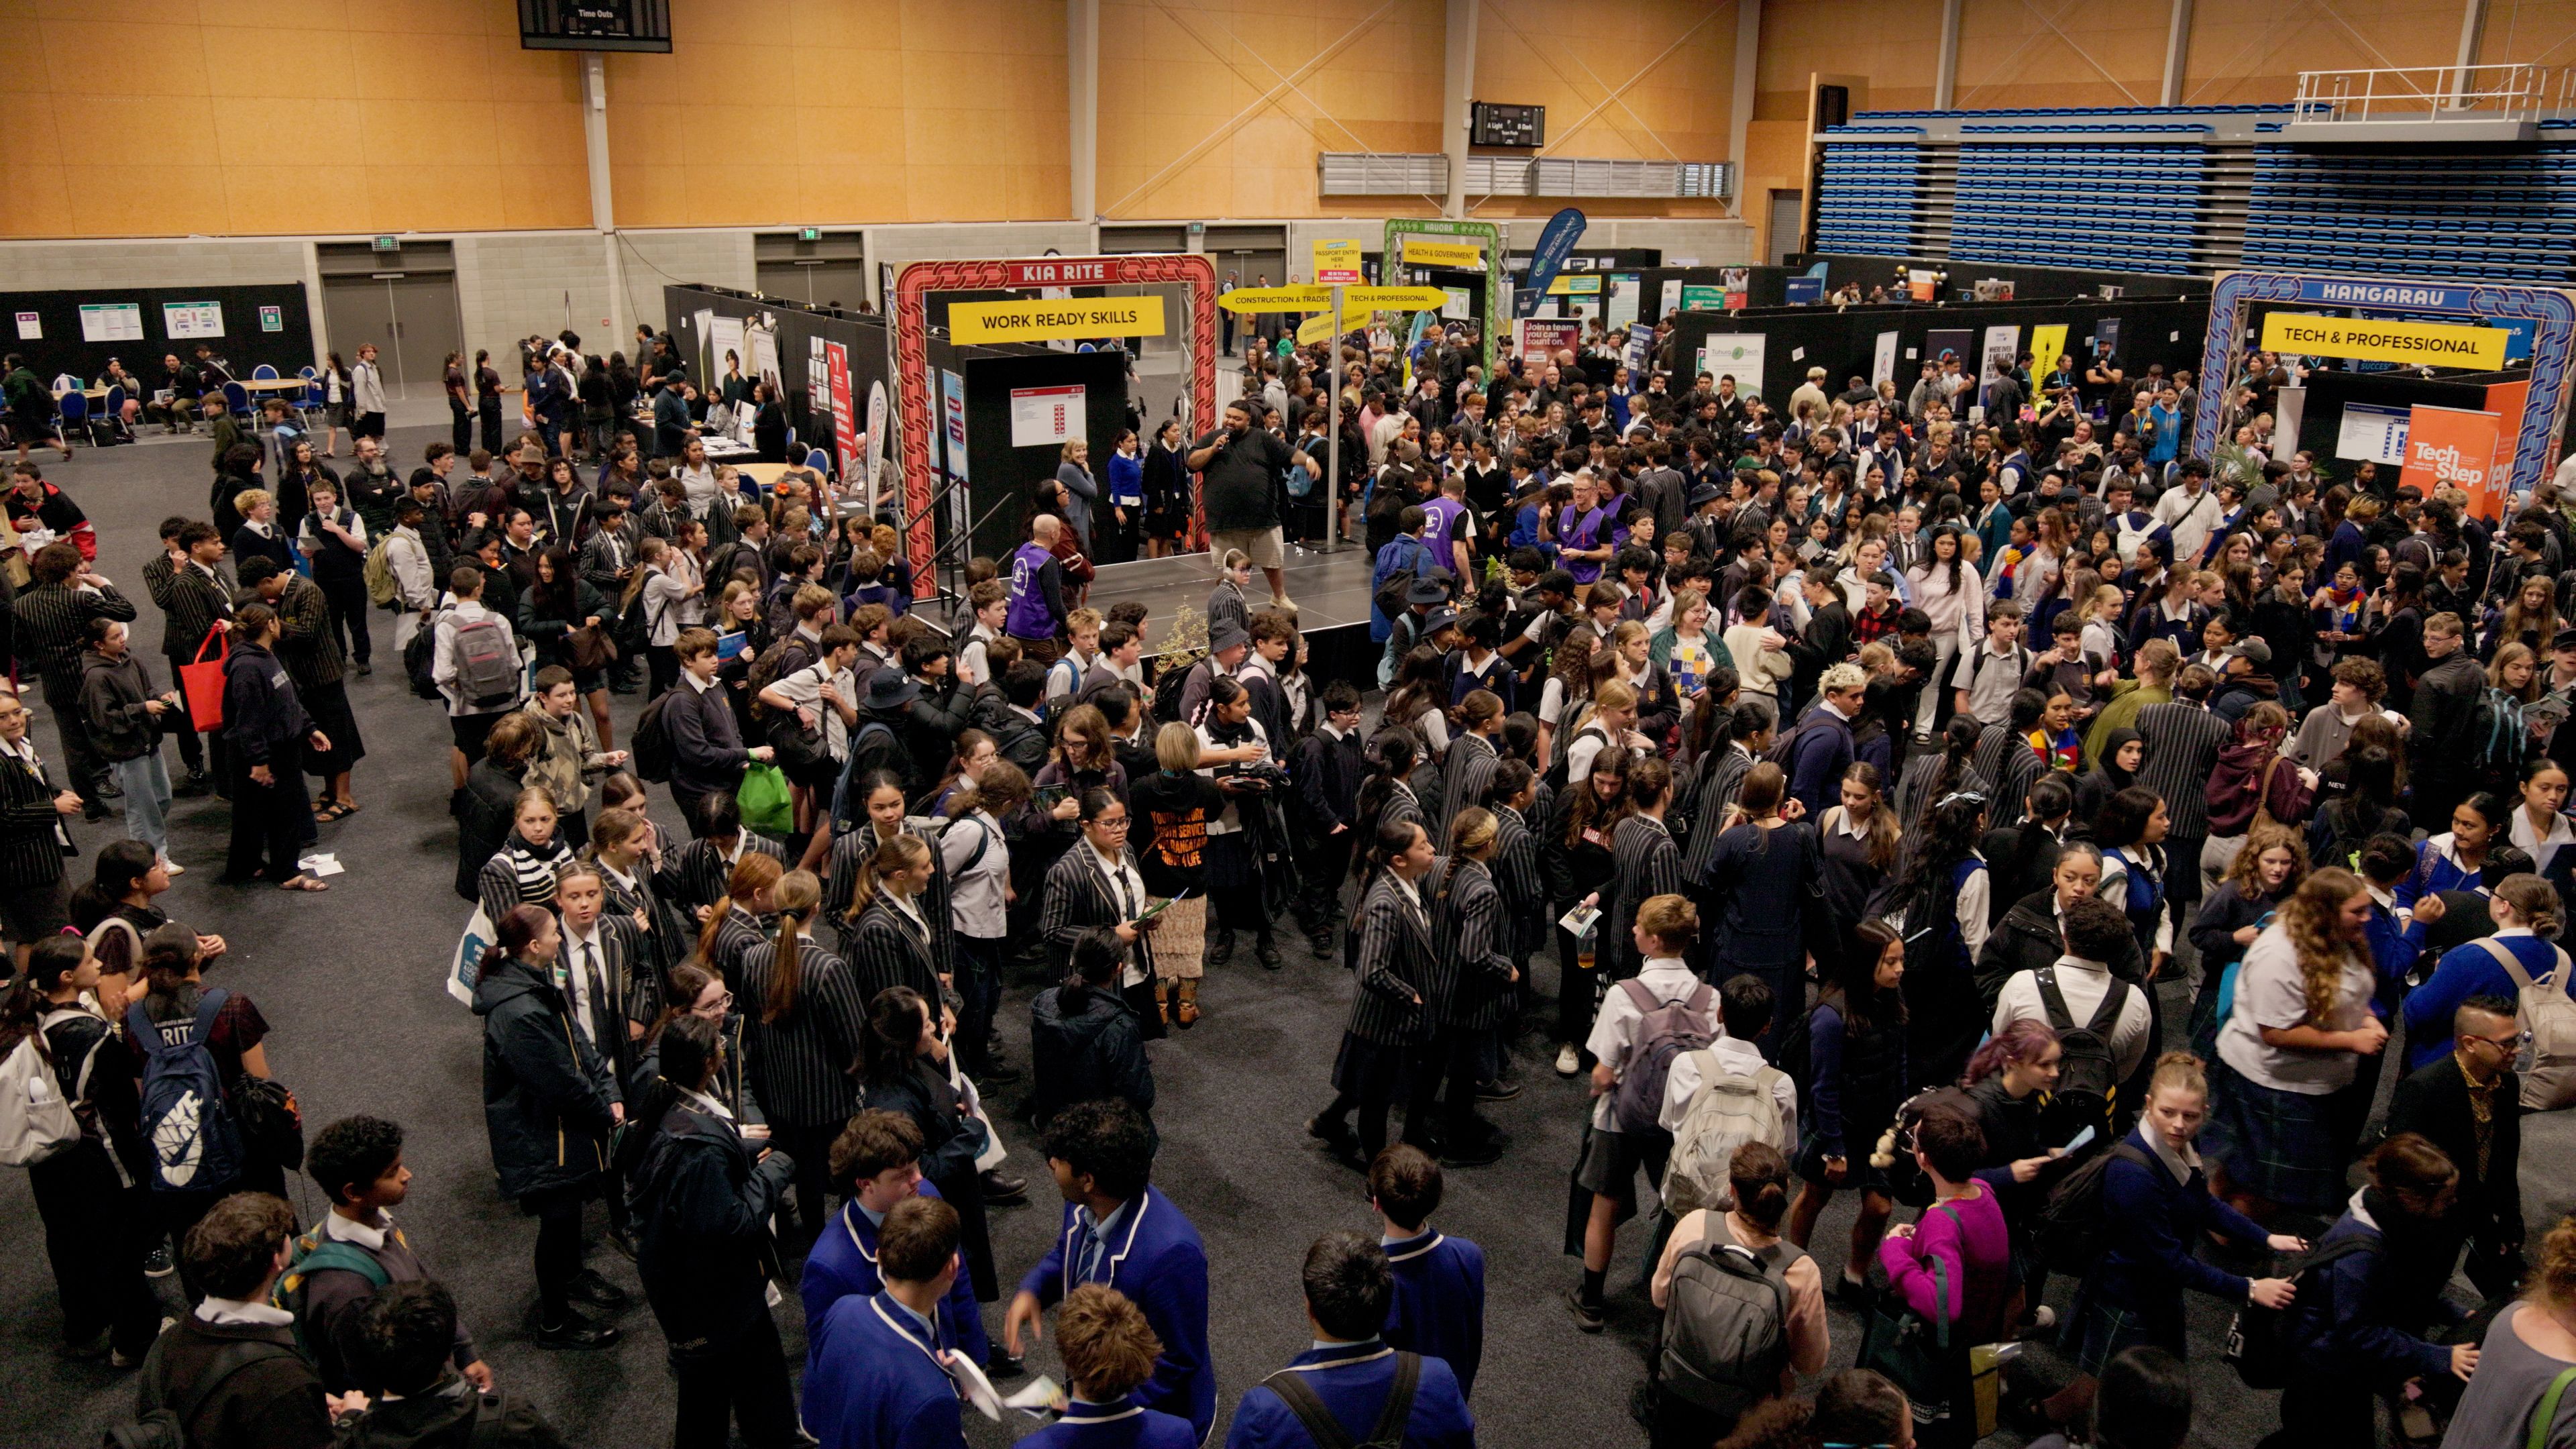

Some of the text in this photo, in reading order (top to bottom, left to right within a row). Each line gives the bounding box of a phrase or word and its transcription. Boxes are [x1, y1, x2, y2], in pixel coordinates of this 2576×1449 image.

[578, 9, 613, 18] Time Outs
[1491, 122, 1503, 130] Light
[1408, 248, 1429, 256] HEALTH
[1434, 250, 1474, 260] GOVERNMENT
[1023, 264, 1104, 281] KIA RITE
[1236, 296, 1295, 304] CONSTRUCTION
[2323, 284, 2445, 307] HANGARAU
[982, 310, 1137, 329] WORK READY SKILLS
[1526, 323, 1545, 331] Join
[2284, 327, 2480, 354] TECH & PROFESSIONAL
[2414, 441, 2460, 464] Tech
[2435, 462, 2483, 487] Step
[1179, 822, 1205, 838] SERVICE
[1182, 853, 1187, 867] 4
[1187, 851, 1202, 867] LIFE
